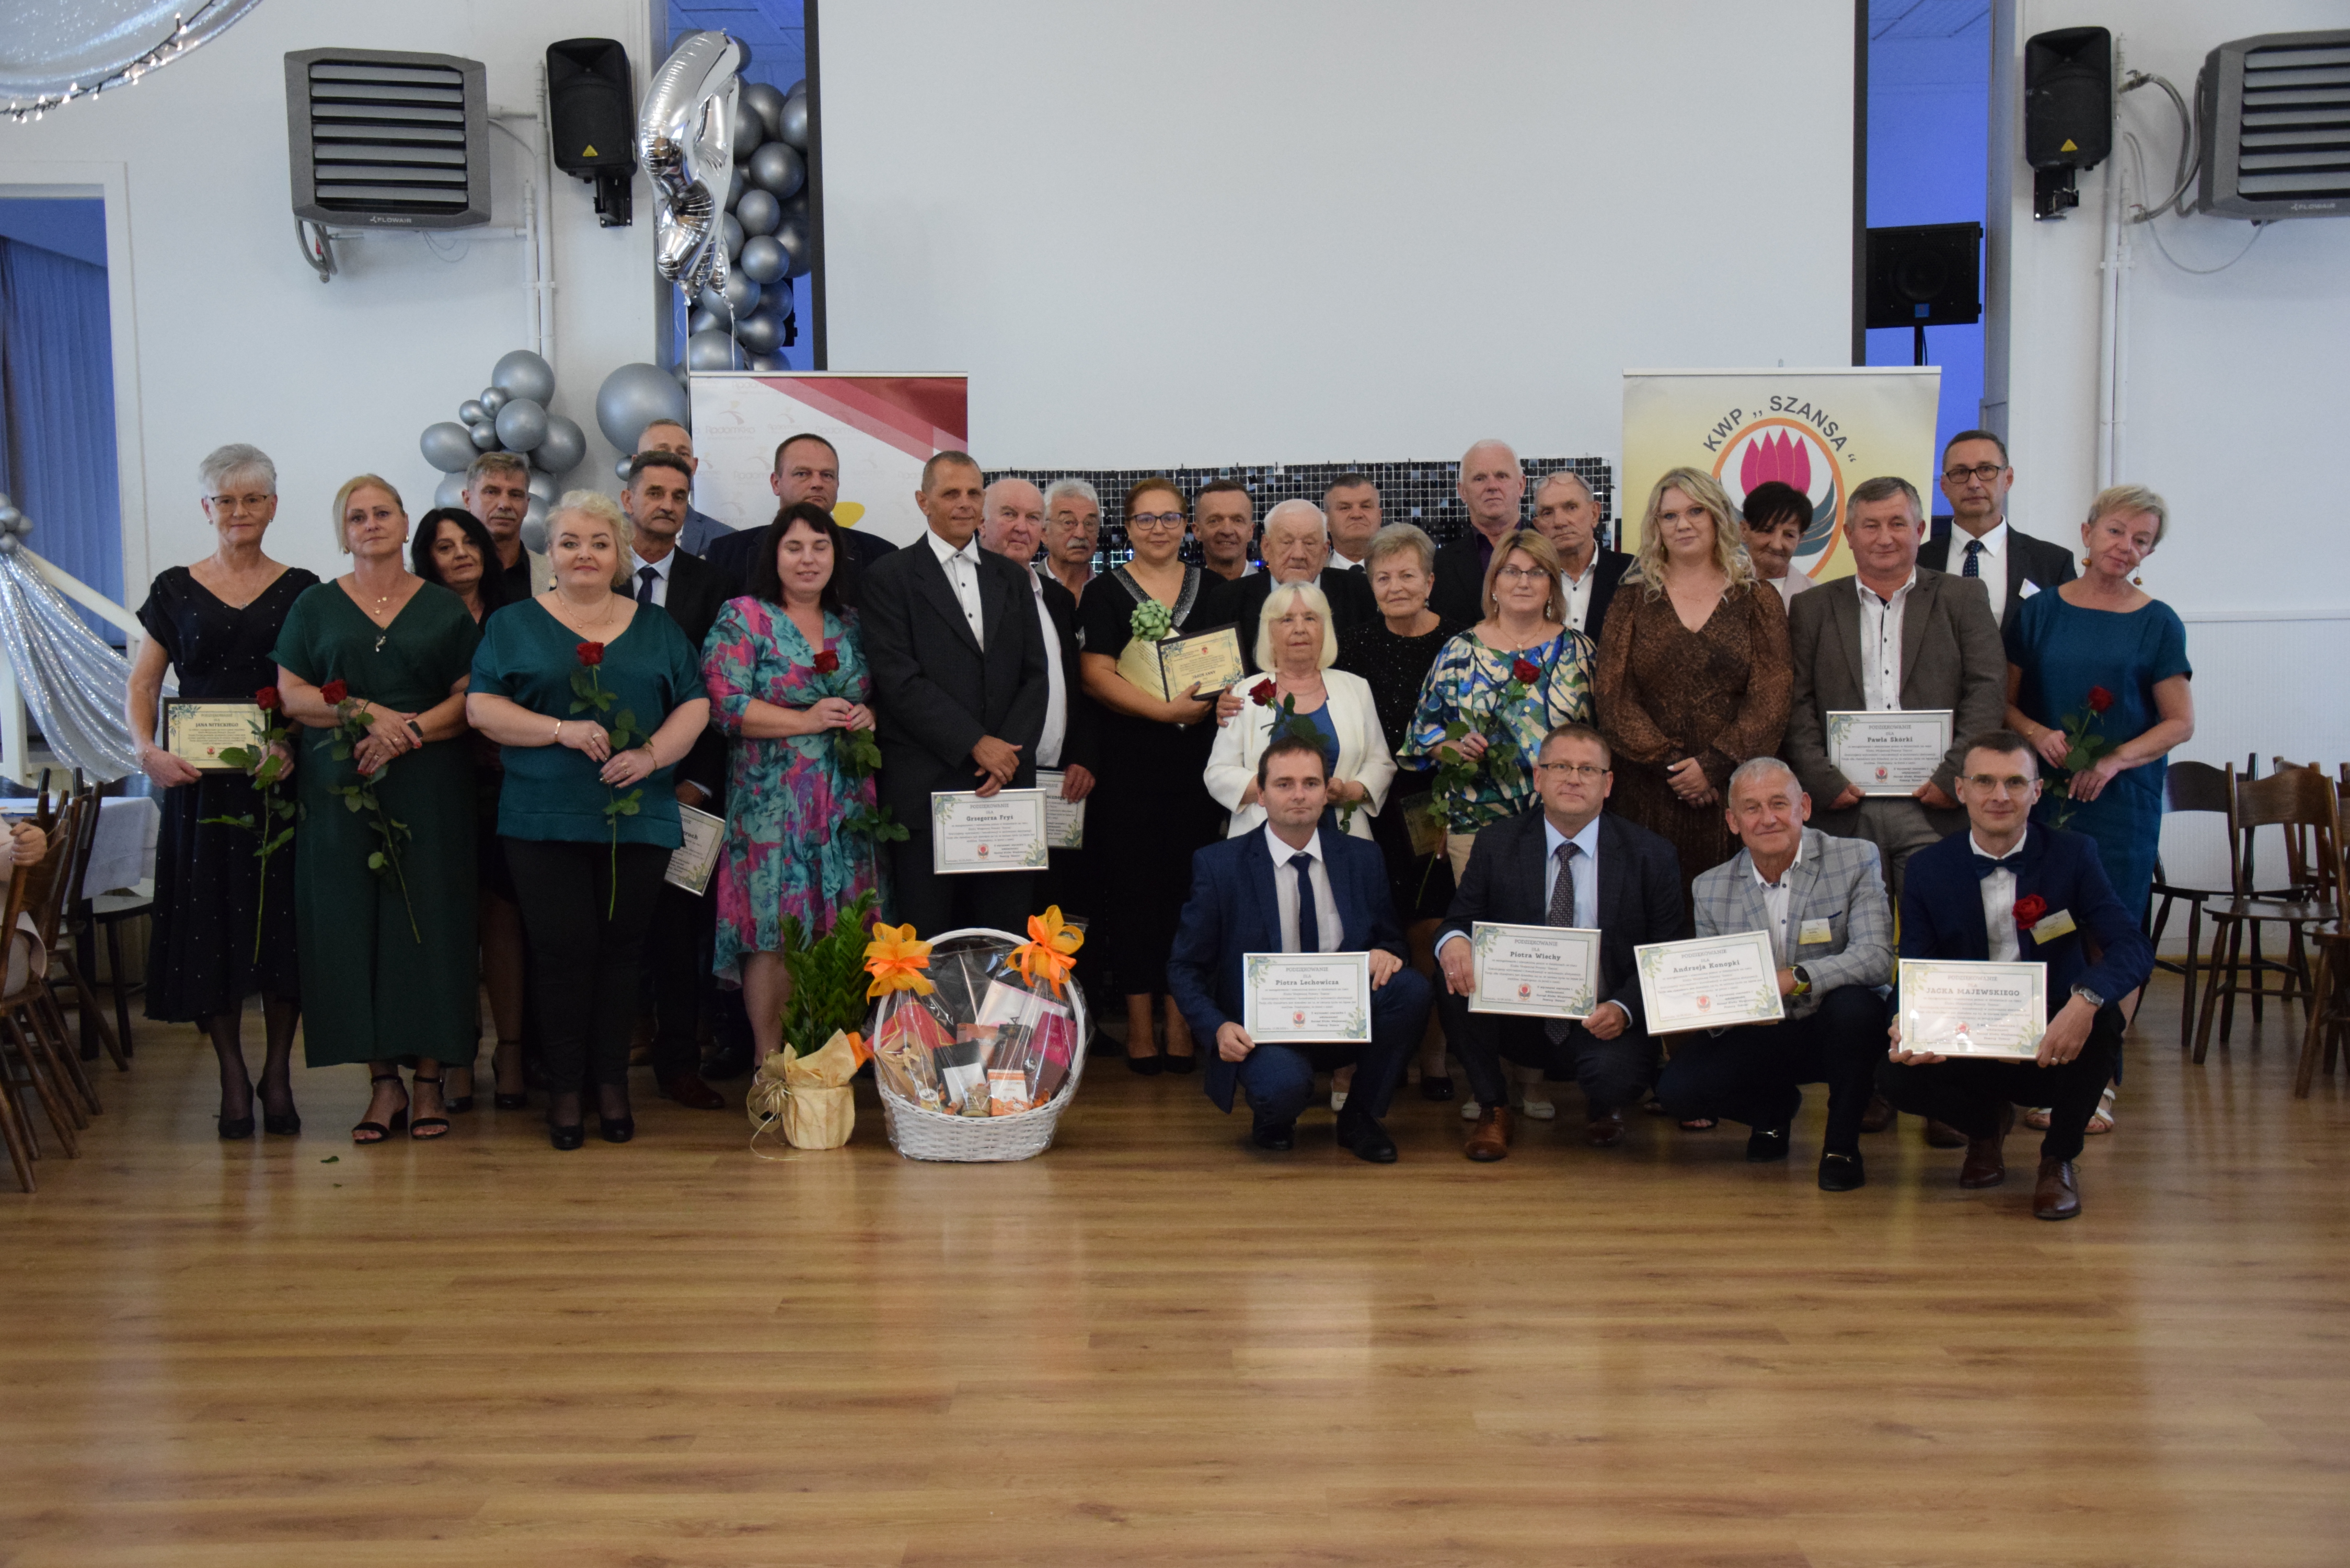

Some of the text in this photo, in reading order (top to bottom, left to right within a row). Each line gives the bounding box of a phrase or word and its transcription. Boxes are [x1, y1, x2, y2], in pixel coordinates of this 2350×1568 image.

[1703, 408, 1742, 452] KWP
[1770, 395, 1847, 452] SZANSA
[1673, 960, 1740, 973] Andrzeja Konopki
